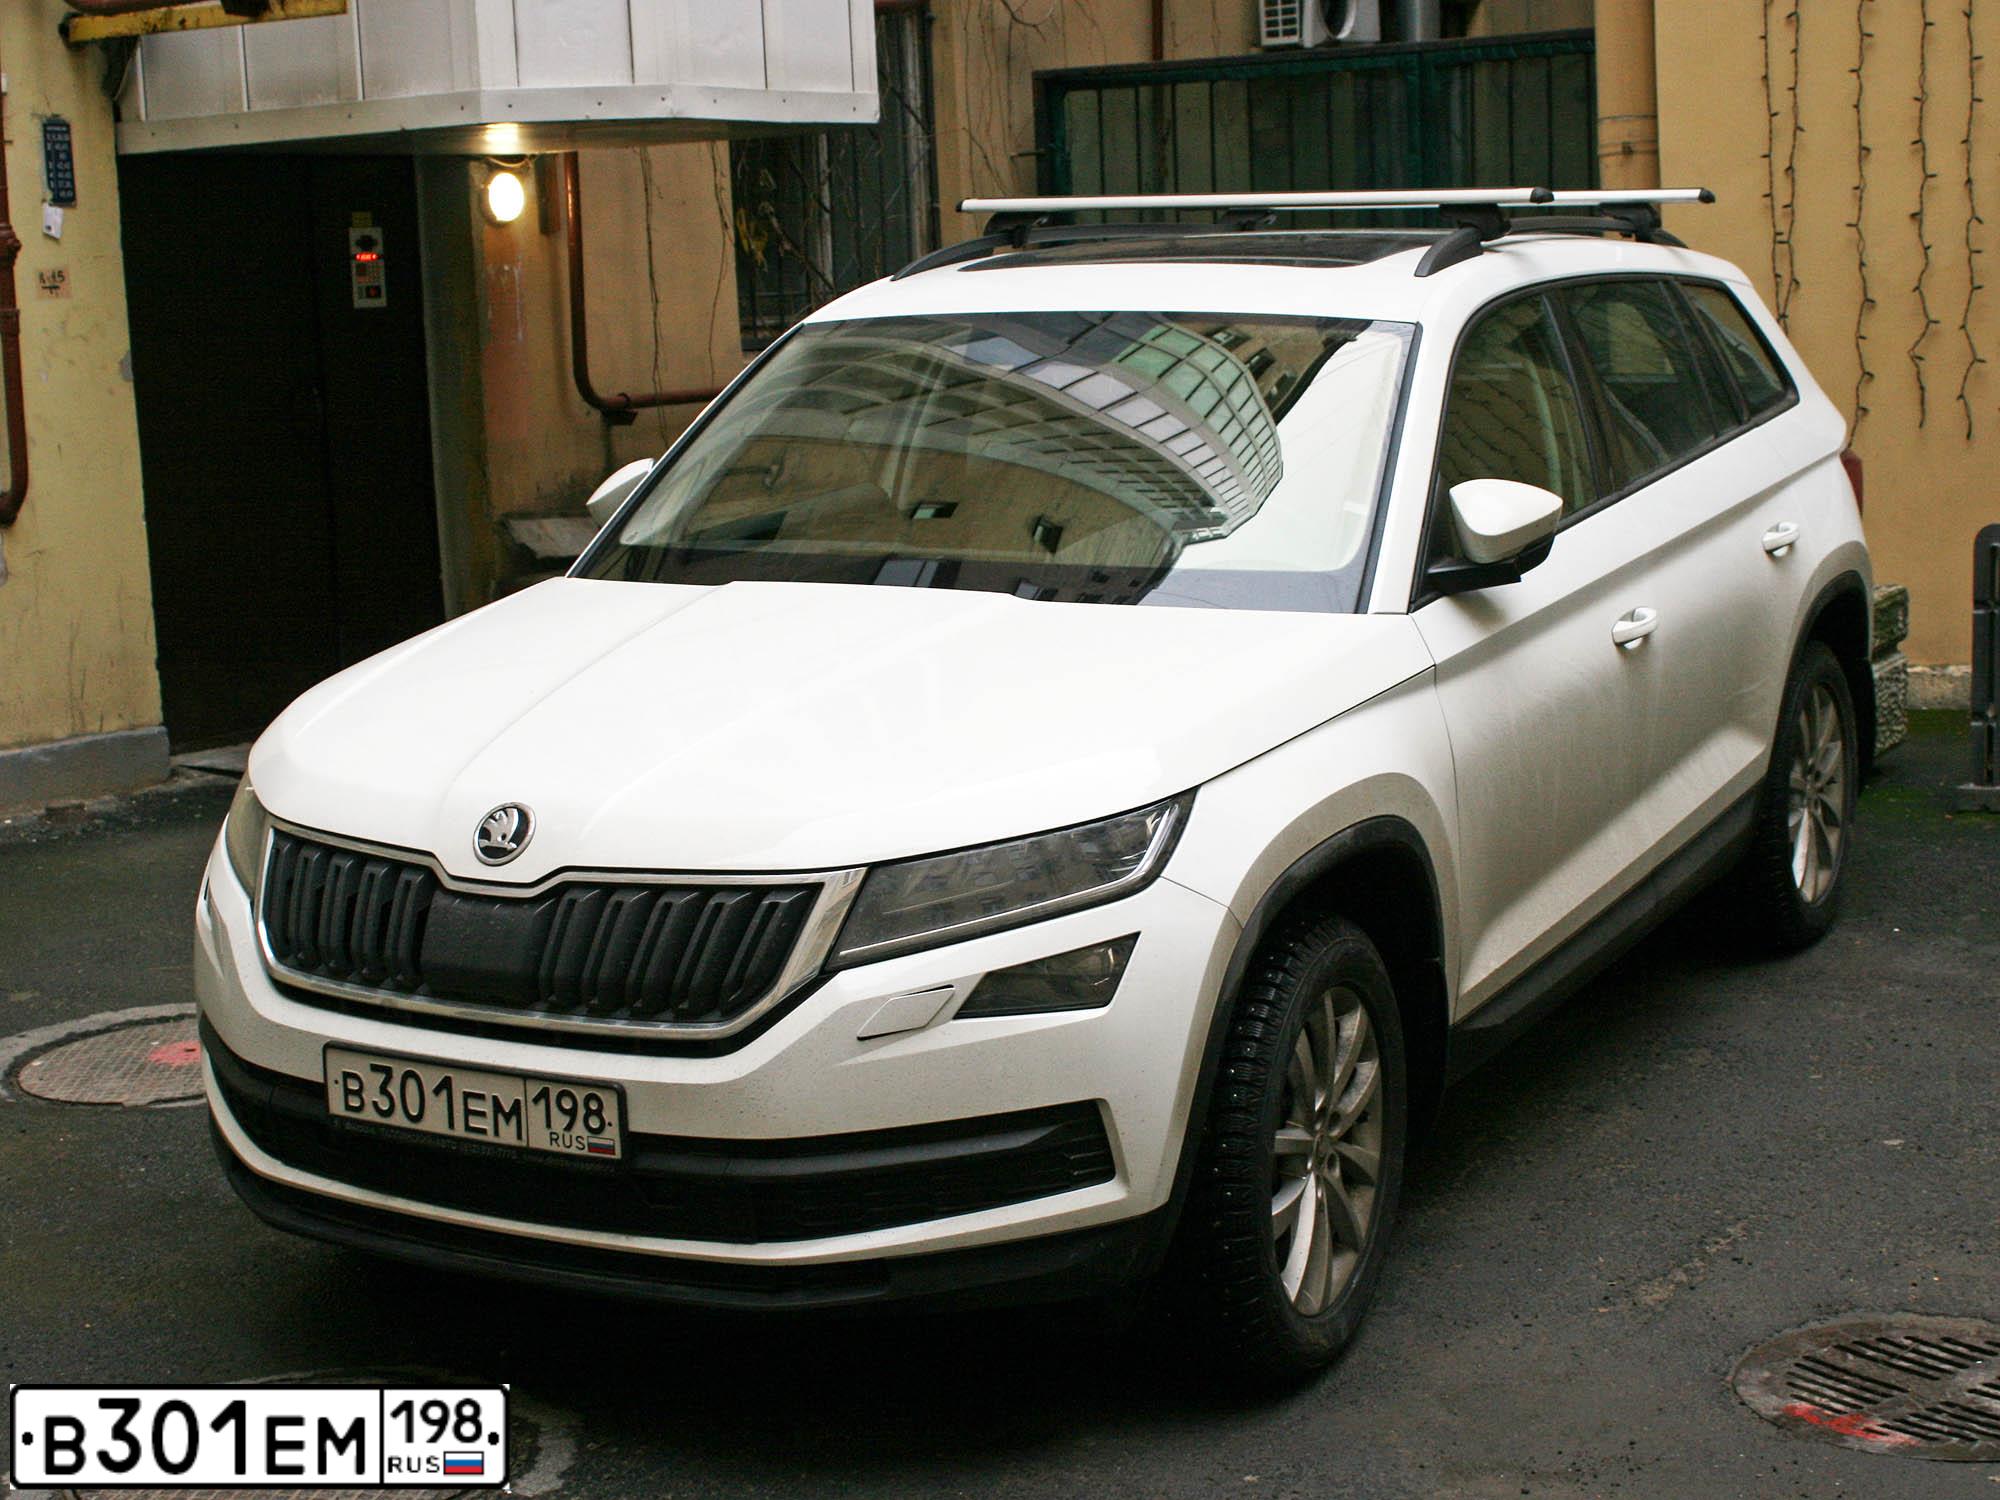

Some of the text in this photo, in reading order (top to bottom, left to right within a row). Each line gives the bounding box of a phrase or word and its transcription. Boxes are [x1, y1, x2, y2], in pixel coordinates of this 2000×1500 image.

[341, 1063, 606, 1141] В301ЕМ 198
[550, 1131, 586, 1151] RUS
